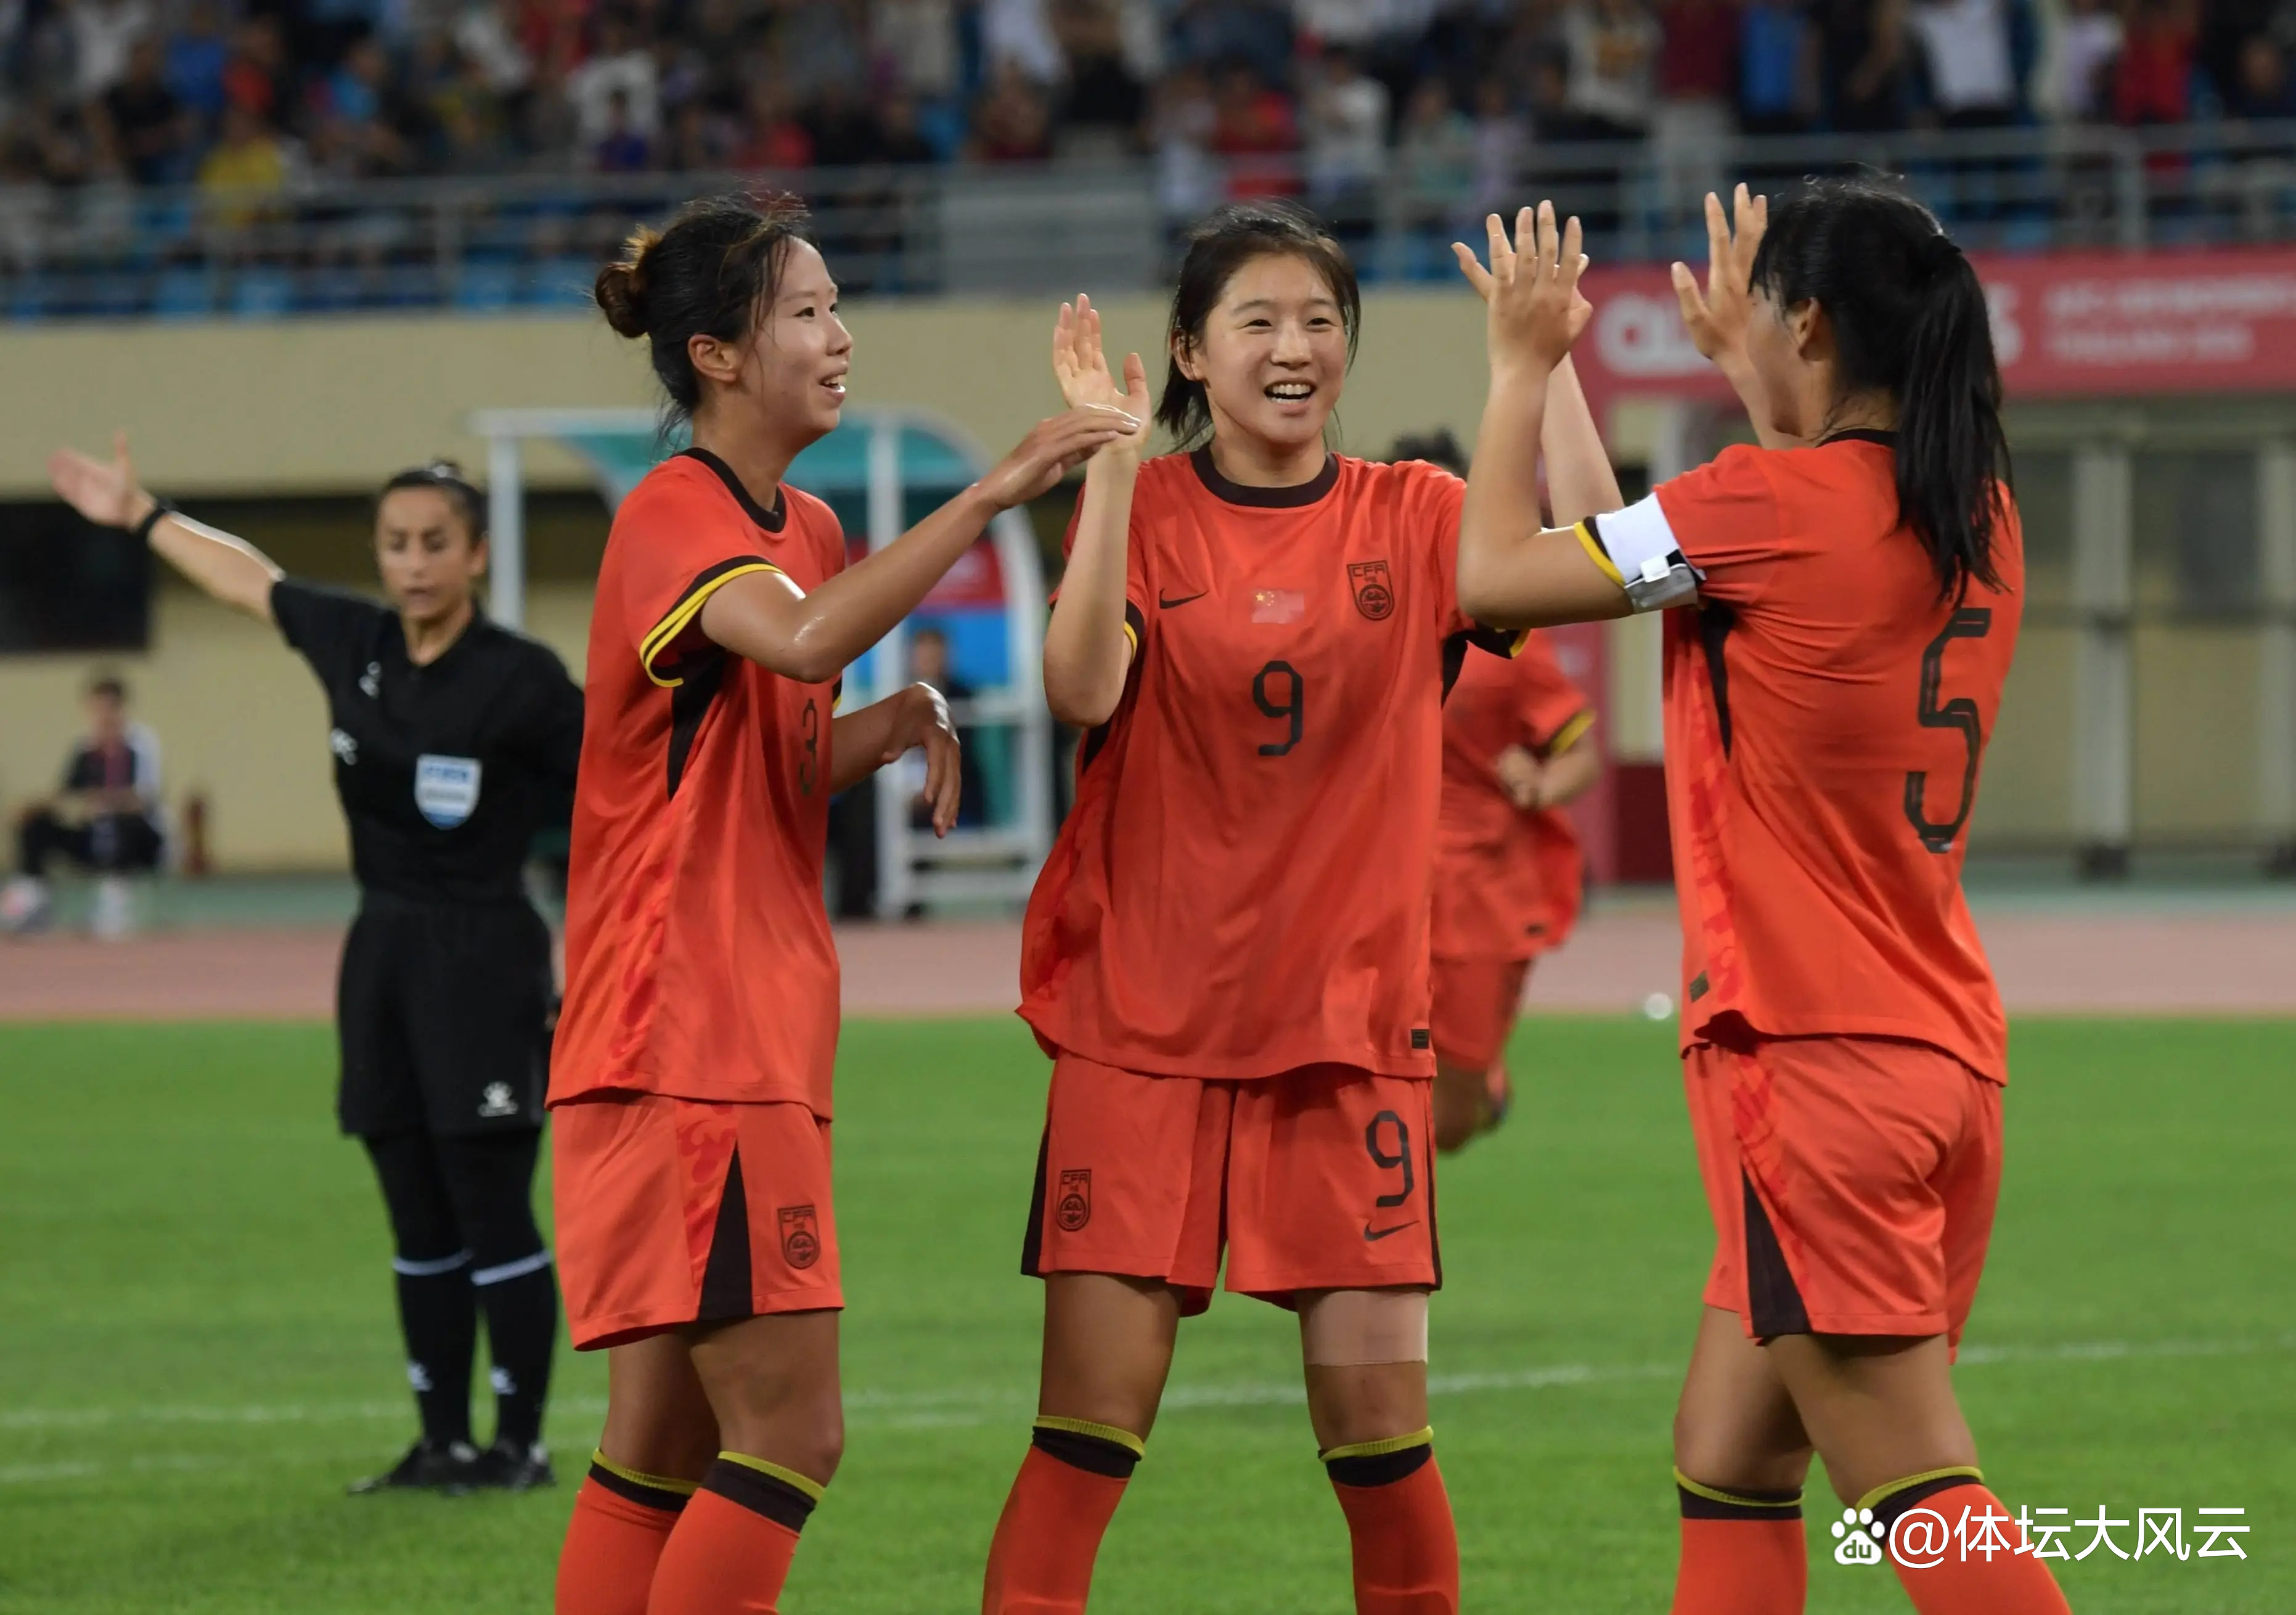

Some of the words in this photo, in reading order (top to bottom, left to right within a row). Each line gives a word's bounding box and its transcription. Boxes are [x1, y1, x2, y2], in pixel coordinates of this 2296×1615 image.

[1352, 563, 1386, 577] CFA
[799, 698, 818, 795] 3
[1252, 660, 1304, 756] 9
[1904, 607, 1992, 854] 5
[1365, 1110, 1415, 1208] 9
